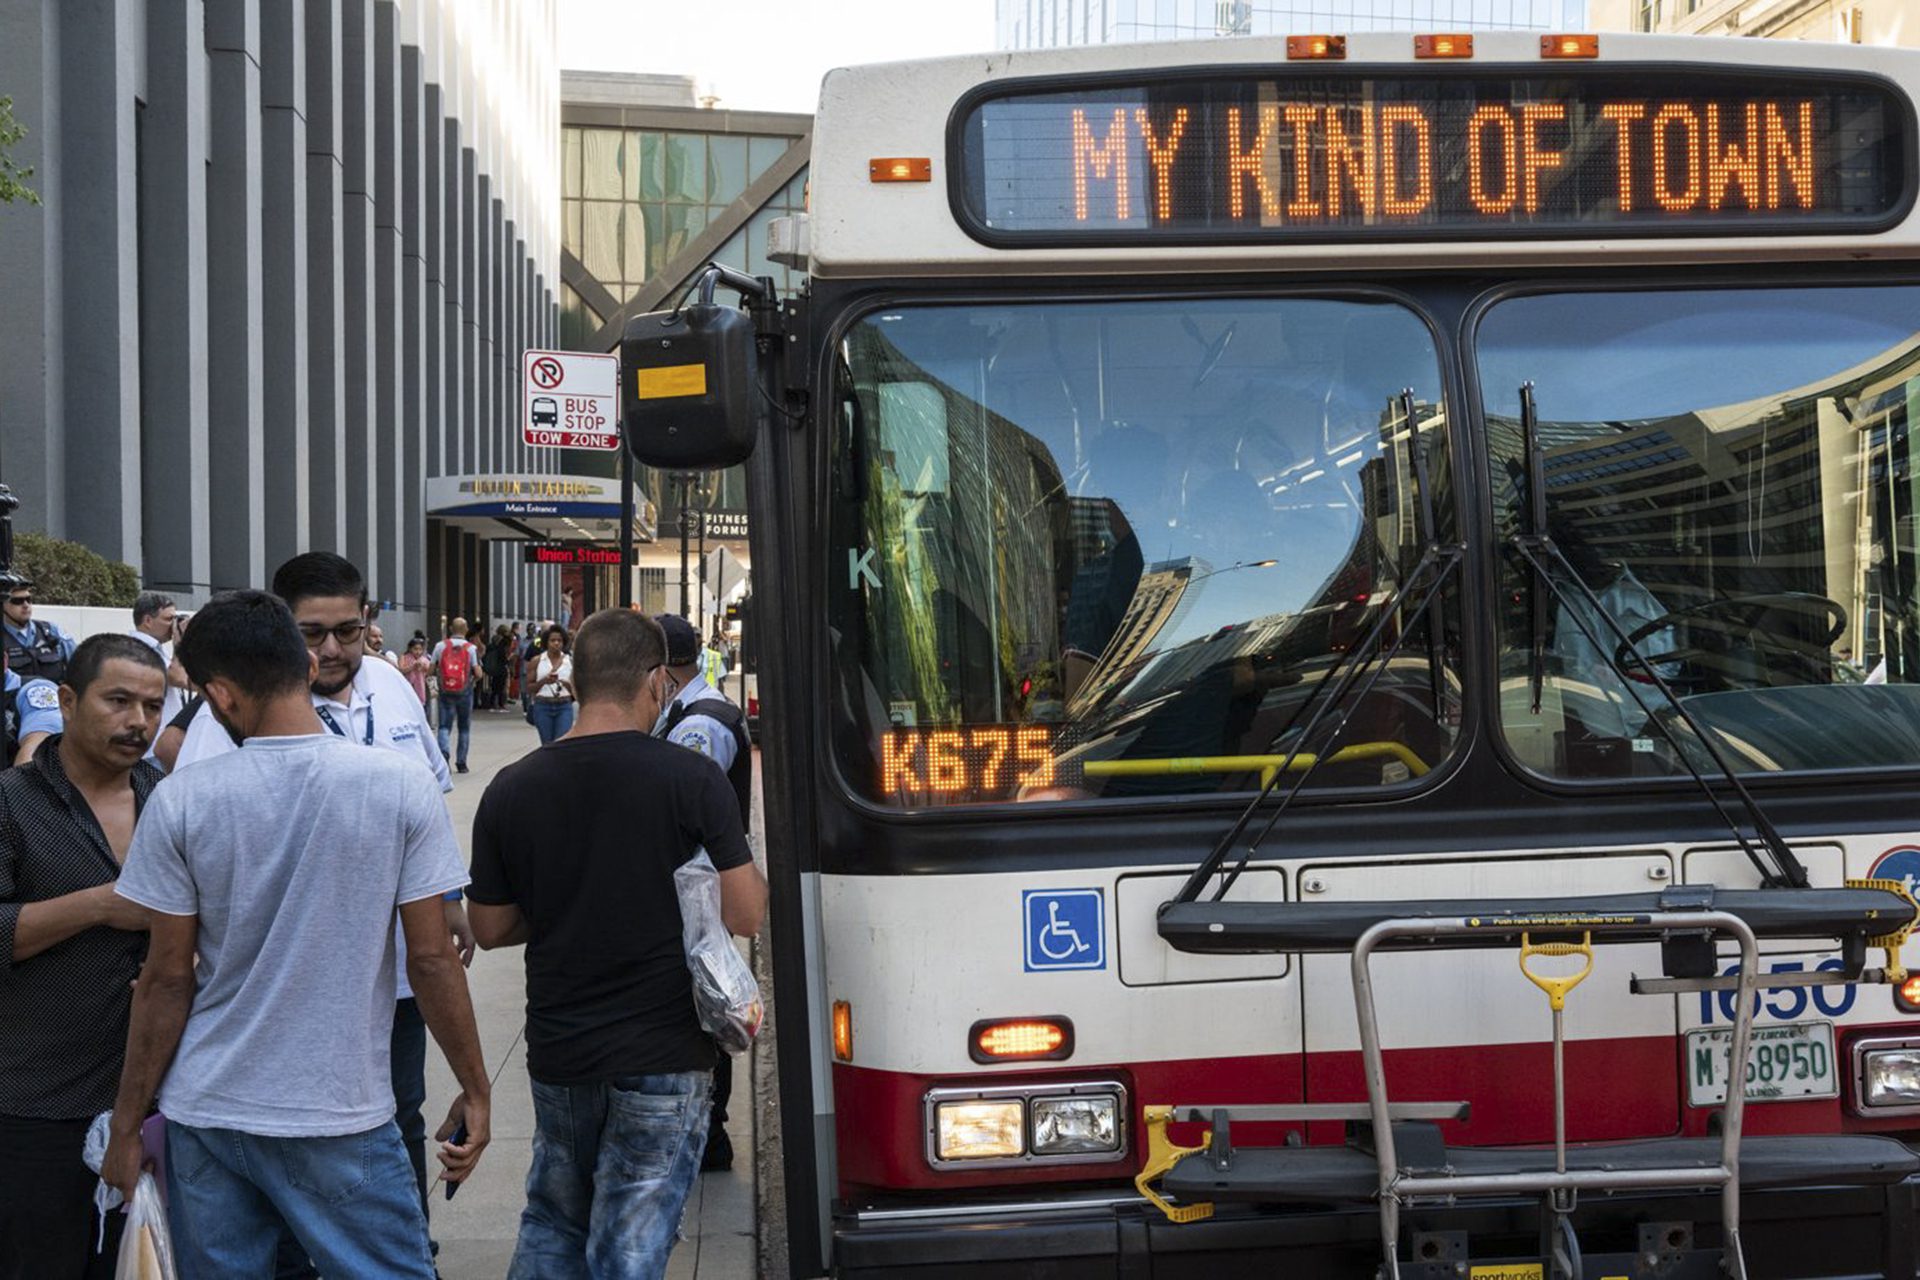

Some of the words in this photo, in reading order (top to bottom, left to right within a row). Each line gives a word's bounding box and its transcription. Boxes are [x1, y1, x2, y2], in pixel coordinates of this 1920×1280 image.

[1072, 108, 1188, 220] MY
[1228, 104, 1432, 218] KIND
[1469, 104, 1565, 214] OF
[1602, 101, 1813, 213] TOWN
[565, 398, 598, 414] BUS
[565, 415, 606, 430] STOP
[530, 431, 562, 444] TOW
[570, 433, 610, 447] ZONE
[505, 504, 525, 512] Main
[527, 504, 557, 513] Entrance
[537, 547, 573, 561] Union
[577, 547, 622, 563] Statio
[848, 547, 883, 590] K
[882, 729, 1055, 793] K675
[1701, 959, 1856, 1024] 1650
